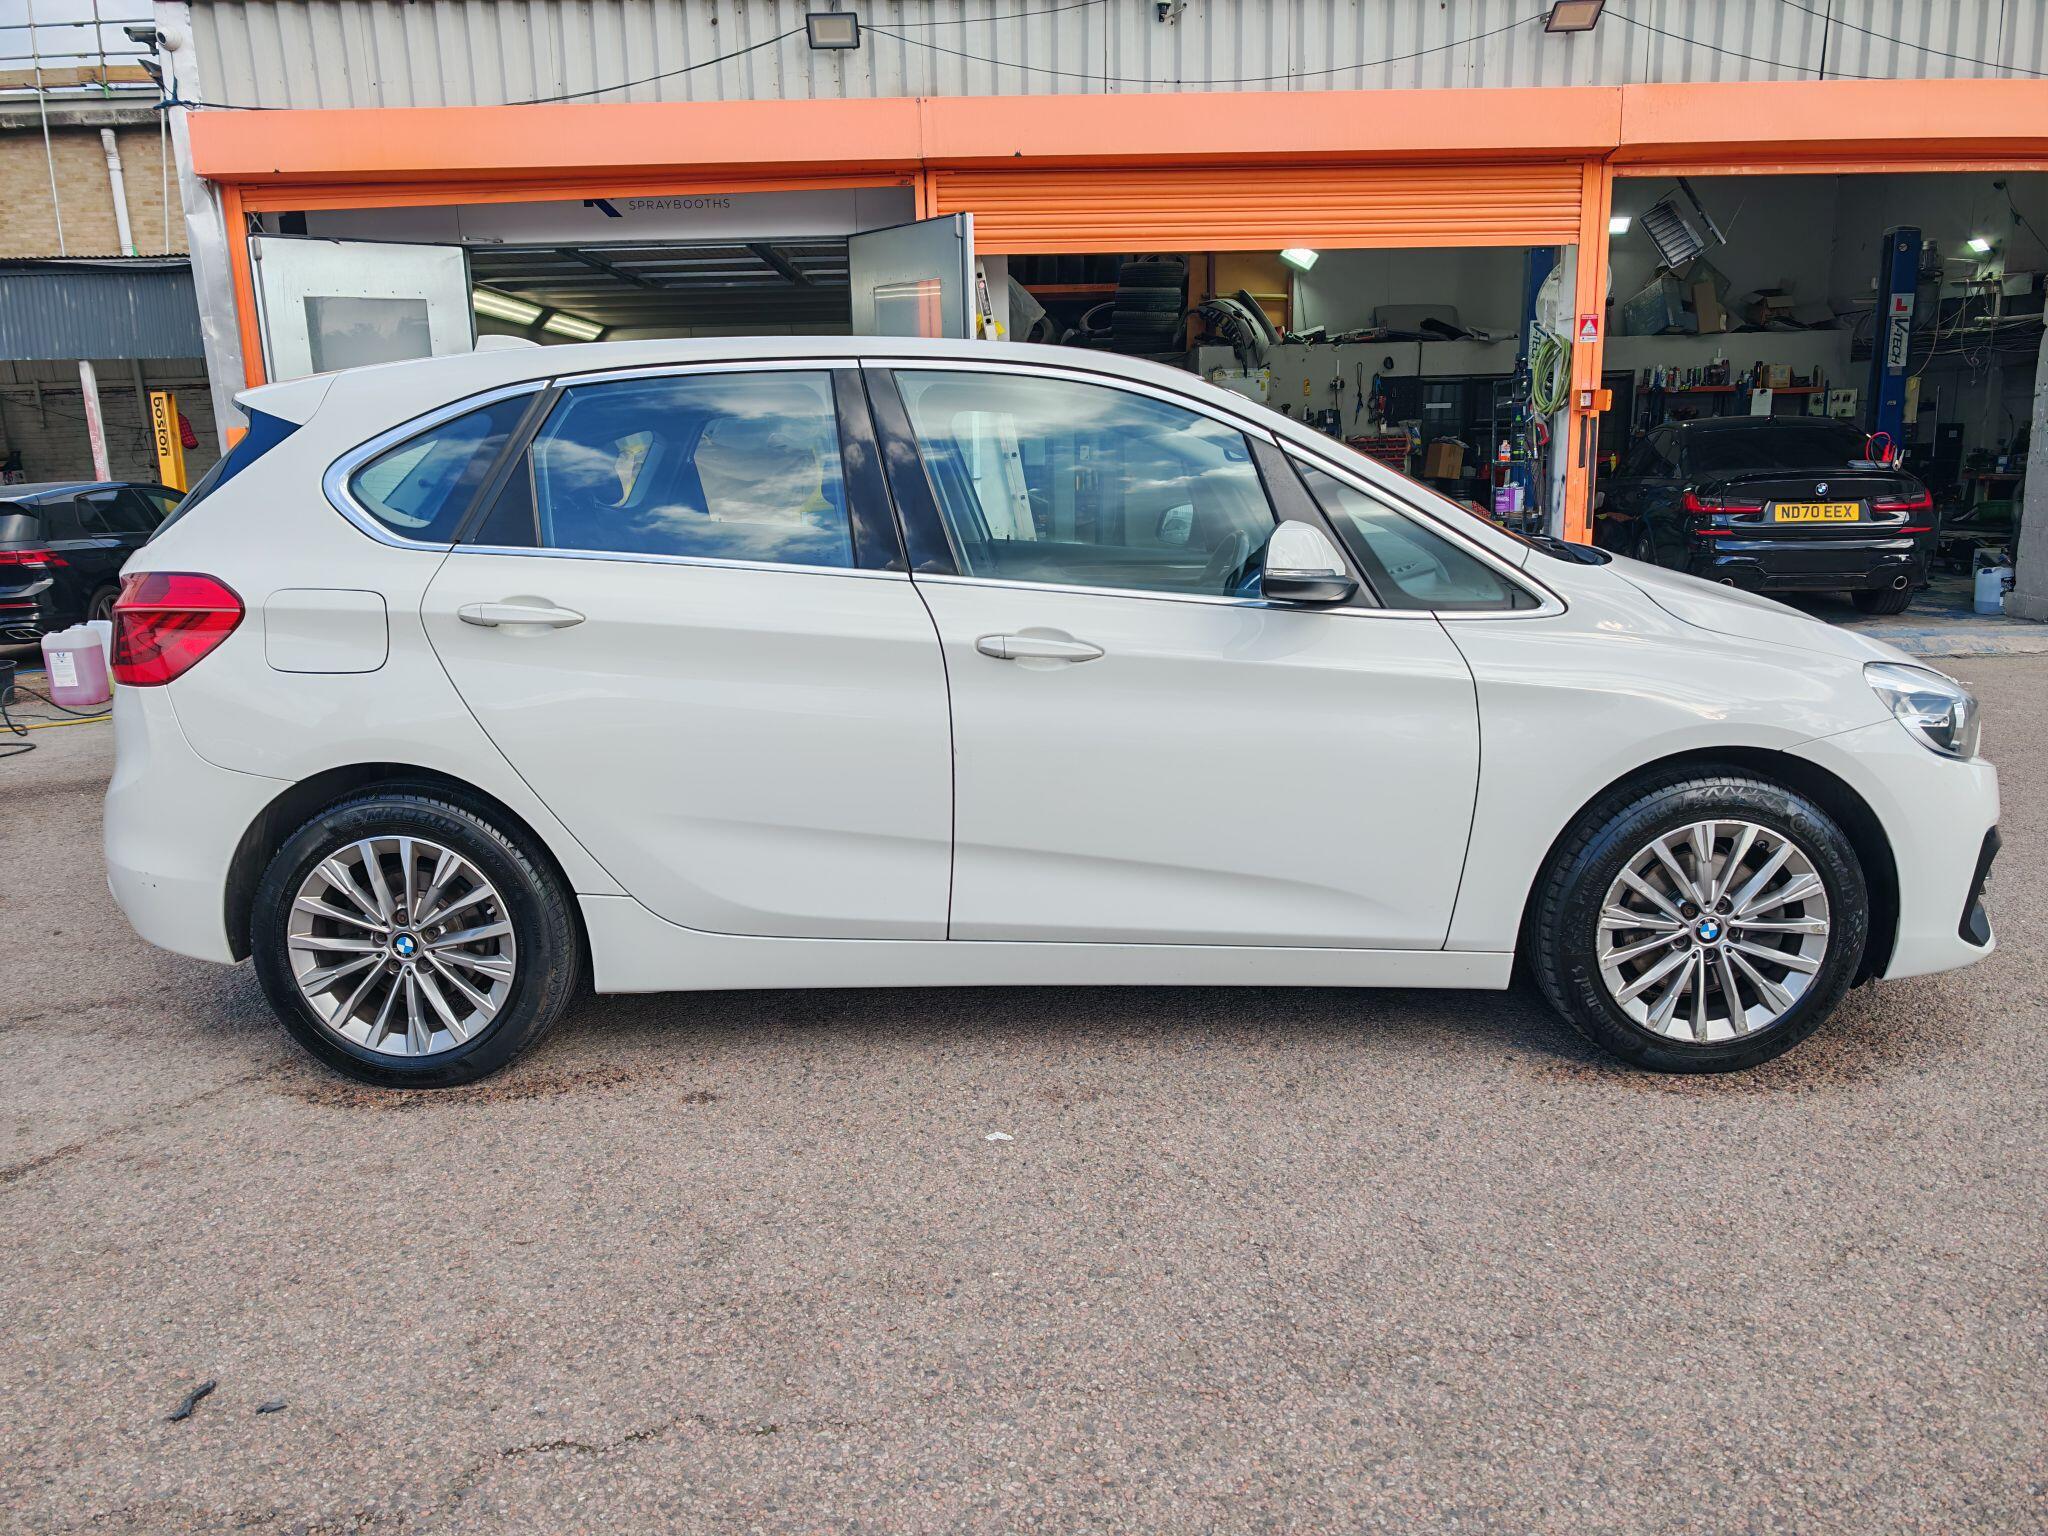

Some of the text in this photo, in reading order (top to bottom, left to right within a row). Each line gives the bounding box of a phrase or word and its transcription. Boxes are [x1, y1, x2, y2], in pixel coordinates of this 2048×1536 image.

[629, 198, 731, 211] SPRAYBOOTHS
[1895, 298, 1908, 311] L
[1891, 318, 1909, 365] V-TECH
[153, 396, 168, 457] boston
[1781, 505, 1852, 519] ND70 EEX
